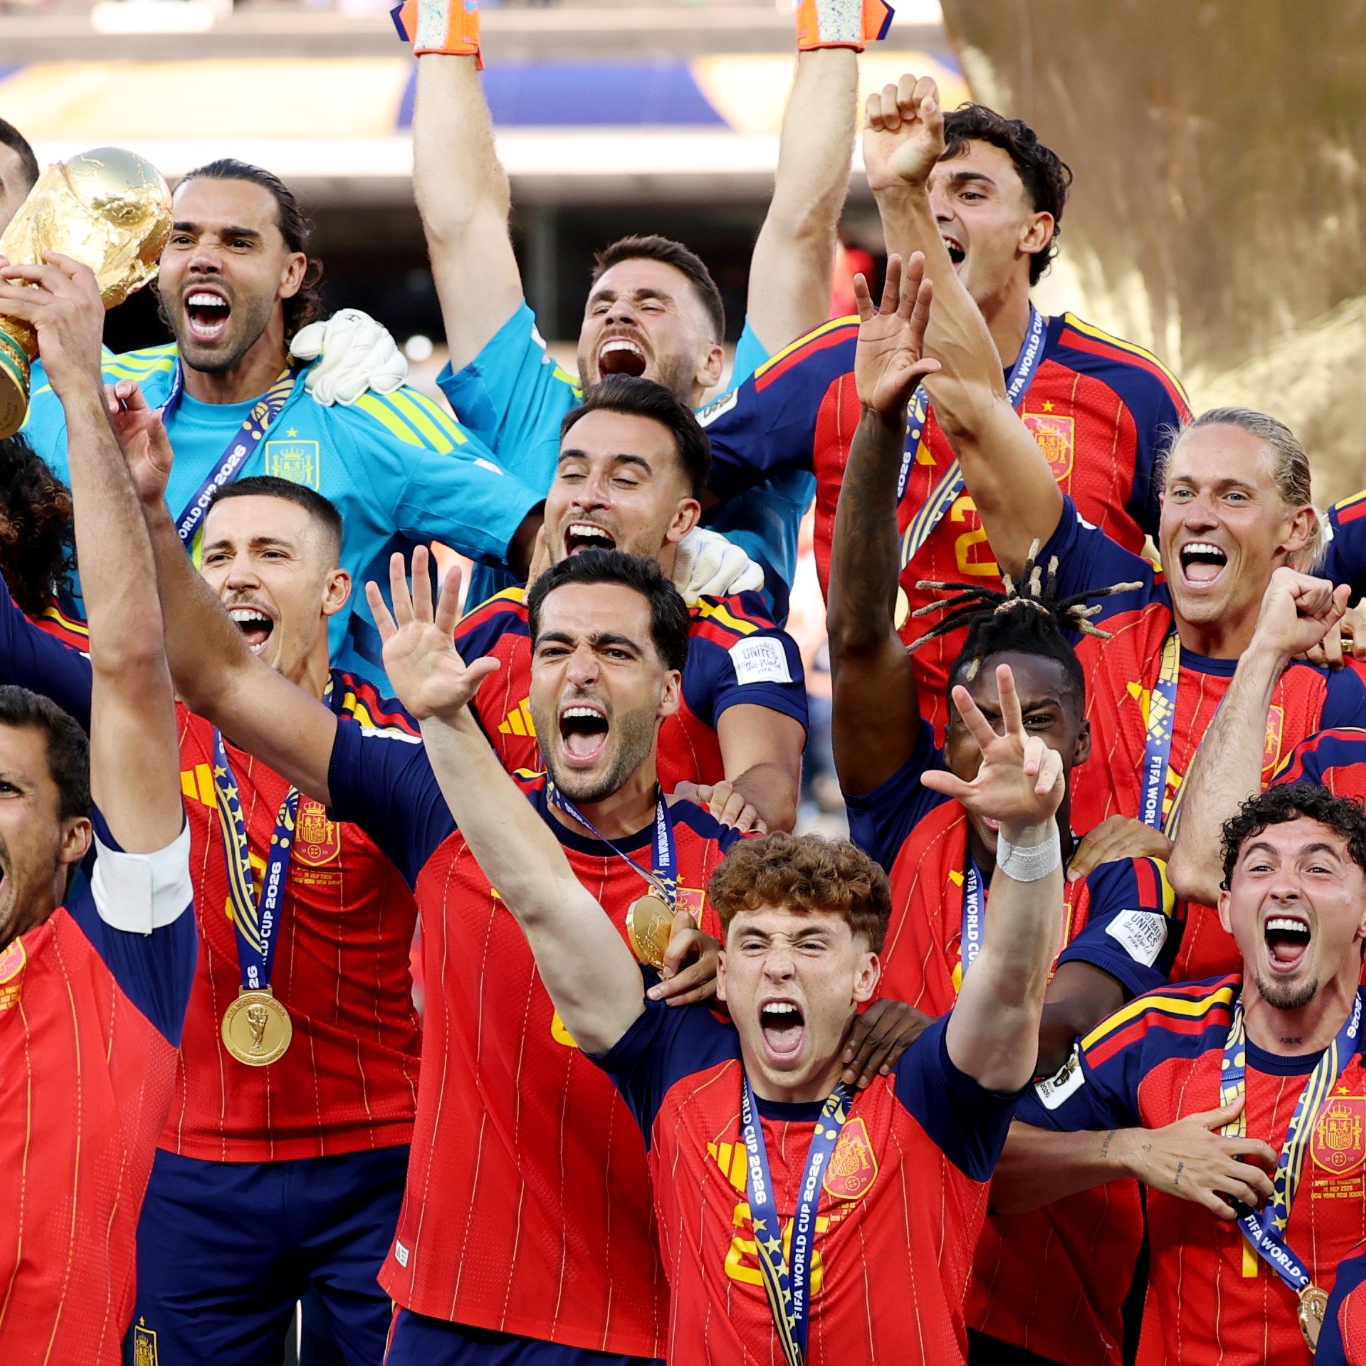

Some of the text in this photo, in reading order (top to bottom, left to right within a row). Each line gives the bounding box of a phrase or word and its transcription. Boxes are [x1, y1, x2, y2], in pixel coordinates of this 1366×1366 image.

[1019, 335, 1041, 377] WORLD
[178, 507, 203, 540] ORLD
[214, 445, 247, 486] 2026
[897, 452, 912, 499] 2026
[1144, 756, 1163, 829] FIFA WORL
[266, 861, 282, 909] 2026
[261, 911, 274, 942] CUP
[966, 892, 979, 944] WORLD
[1131, 913, 1158, 948] UNITES
[743, 1127, 758, 1153] CUP
[749, 1154, 767, 1206] 2026
[792, 1151, 825, 1320] FIFA WORLD CUP 2026
[1243, 1213, 1264, 1243] FIFA
[1260, 1231, 1302, 1282] WORLD
